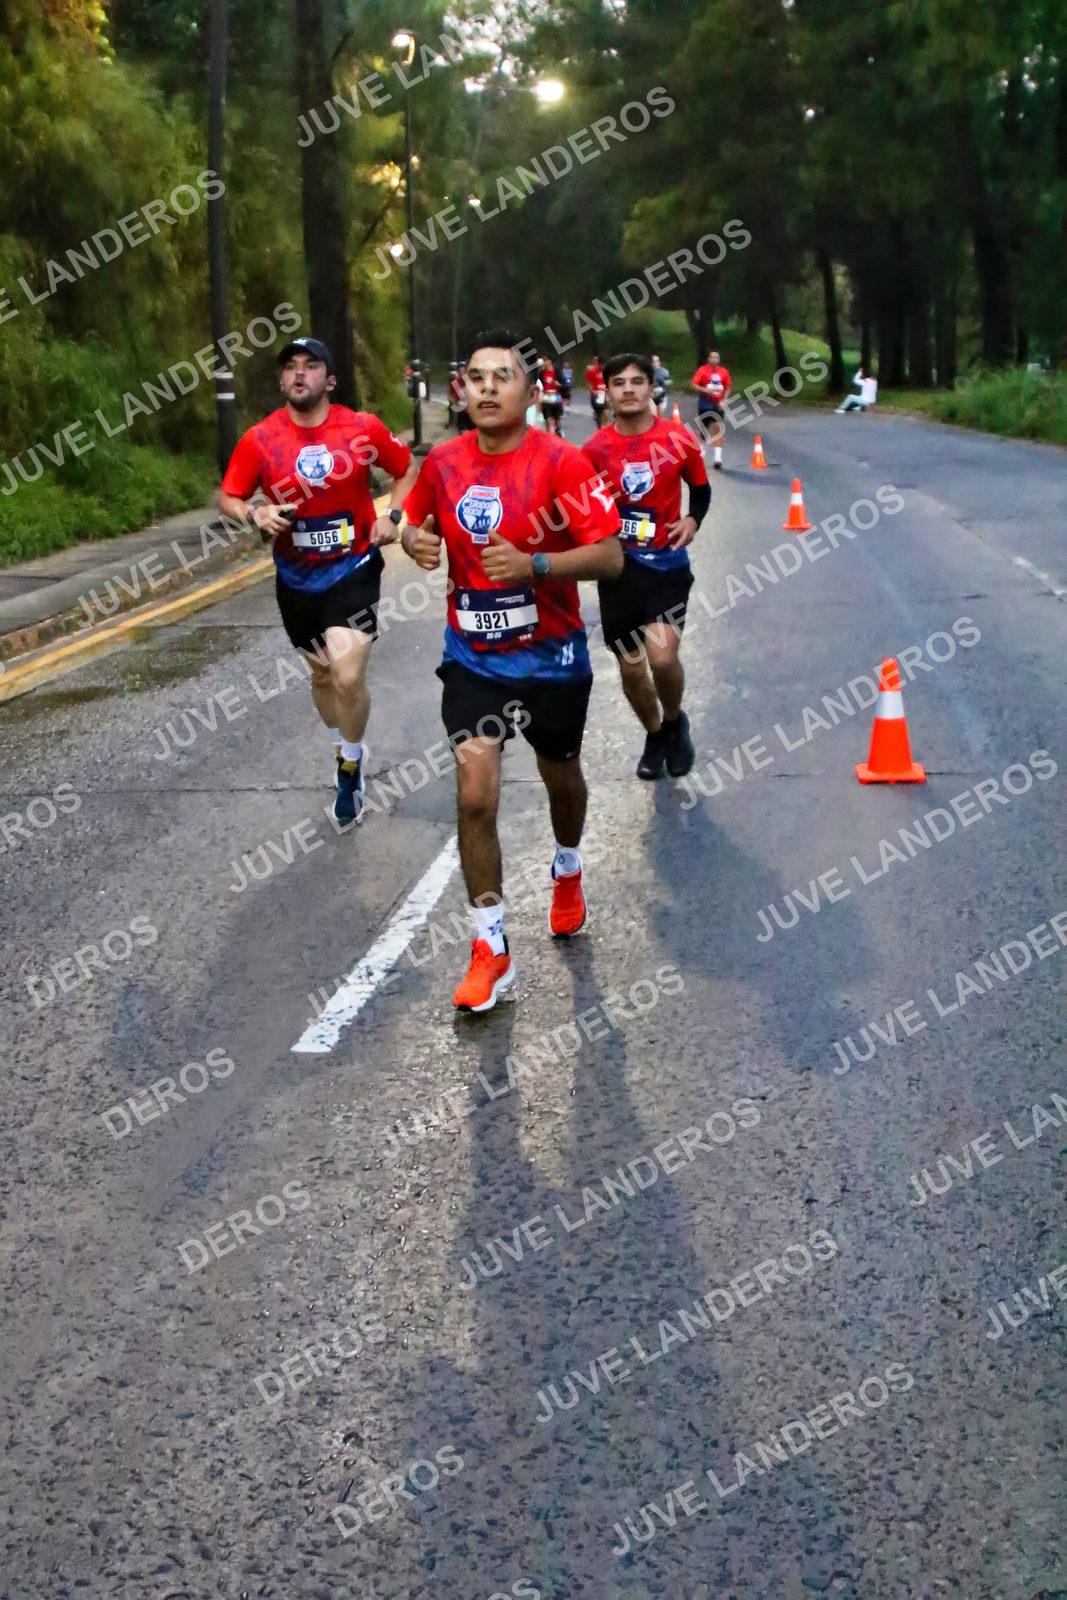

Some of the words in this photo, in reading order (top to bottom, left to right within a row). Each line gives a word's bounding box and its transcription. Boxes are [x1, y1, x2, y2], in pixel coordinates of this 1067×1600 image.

[620, 519, 637, 533] 66
[310, 531, 338, 545] 5056
[475, 611, 509, 630] 3921
